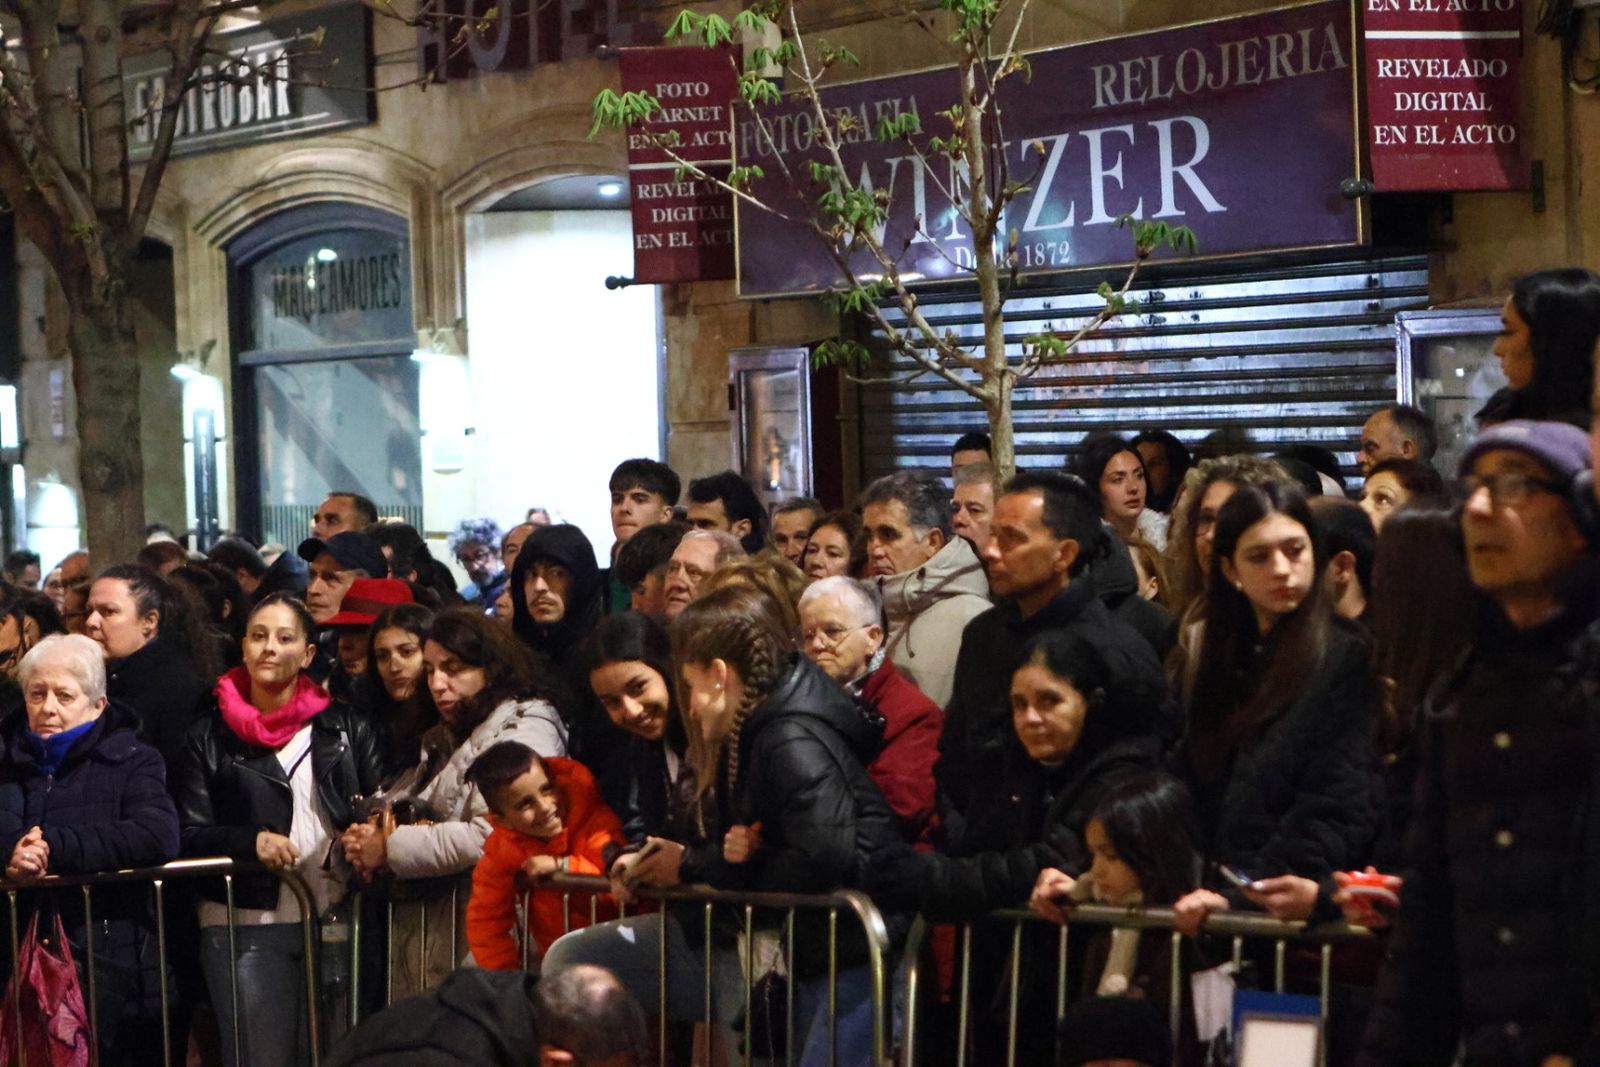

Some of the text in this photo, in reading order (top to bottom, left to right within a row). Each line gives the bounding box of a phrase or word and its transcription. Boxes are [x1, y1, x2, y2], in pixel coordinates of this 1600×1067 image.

[1368, 0, 1514, 12] EN EL ACTO
[1091, 21, 1349, 108] RELOJERIA
[1376, 58, 1508, 79] REVELADO
[656, 82, 710, 98] FOTO
[1394, 91, 1493, 112] DIGITAL
[645, 106, 722, 123] CARNET
[1374, 124, 1516, 145] EN EL ACTO
[652, 204, 731, 223] DIGITAL
[637, 234, 662, 249] EN
[668, 232, 694, 248] EL
[1024, 240, 1071, 267] 1872
